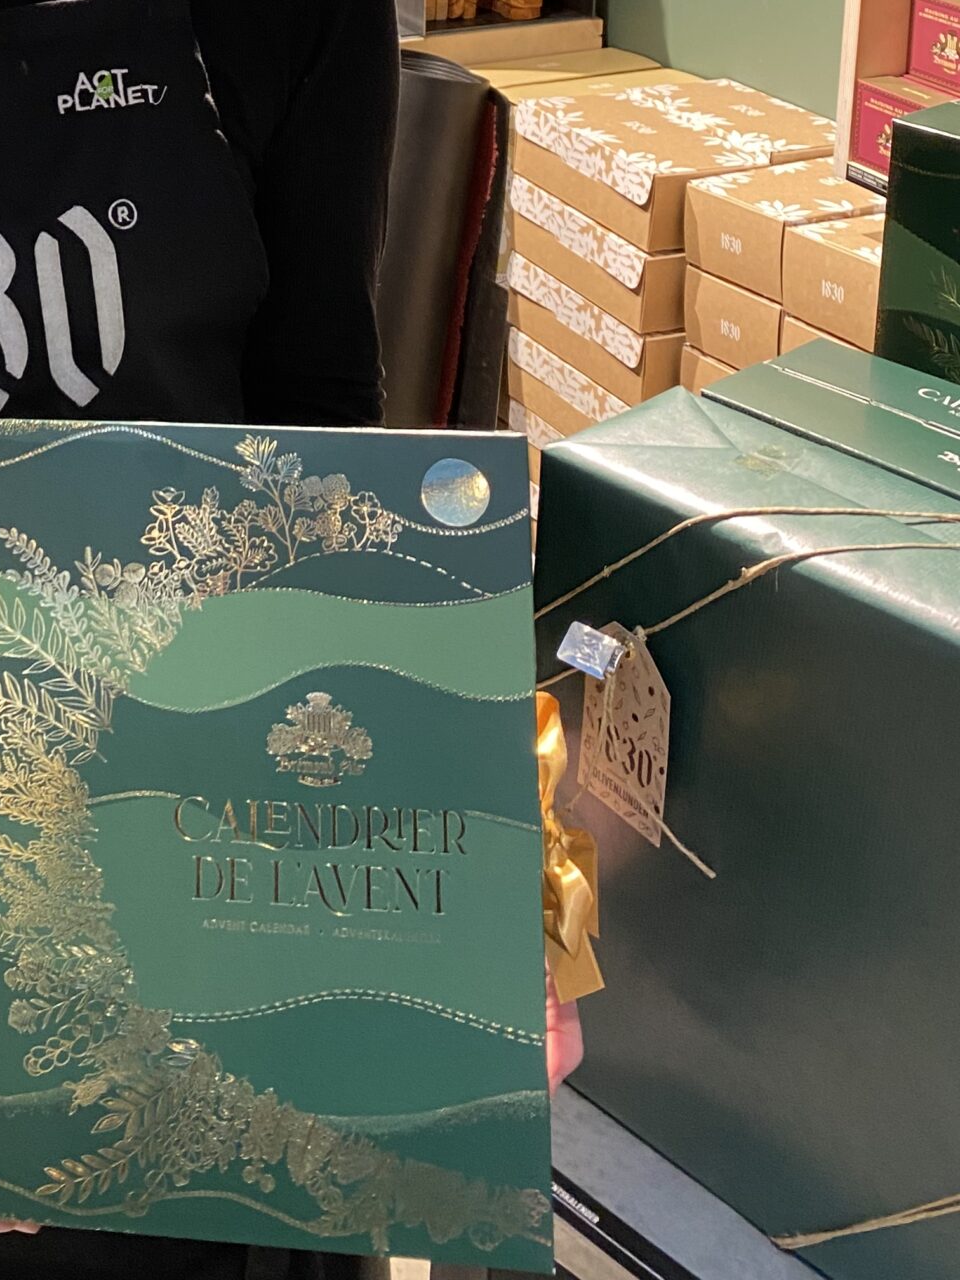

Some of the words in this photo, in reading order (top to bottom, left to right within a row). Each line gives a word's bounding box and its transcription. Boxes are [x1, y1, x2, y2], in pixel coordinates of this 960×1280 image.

[74, 68, 129, 93] ACT
[57, 84, 167, 114] PLANET
[720, 232, 742, 255] 1830
[821, 279, 844, 304] 1830
[720, 318, 741, 341] 1830
[174, 795, 468, 856] CALENDRIER
[192, 856, 254, 904] DE
[270, 858, 451, 917] L'AVENT
